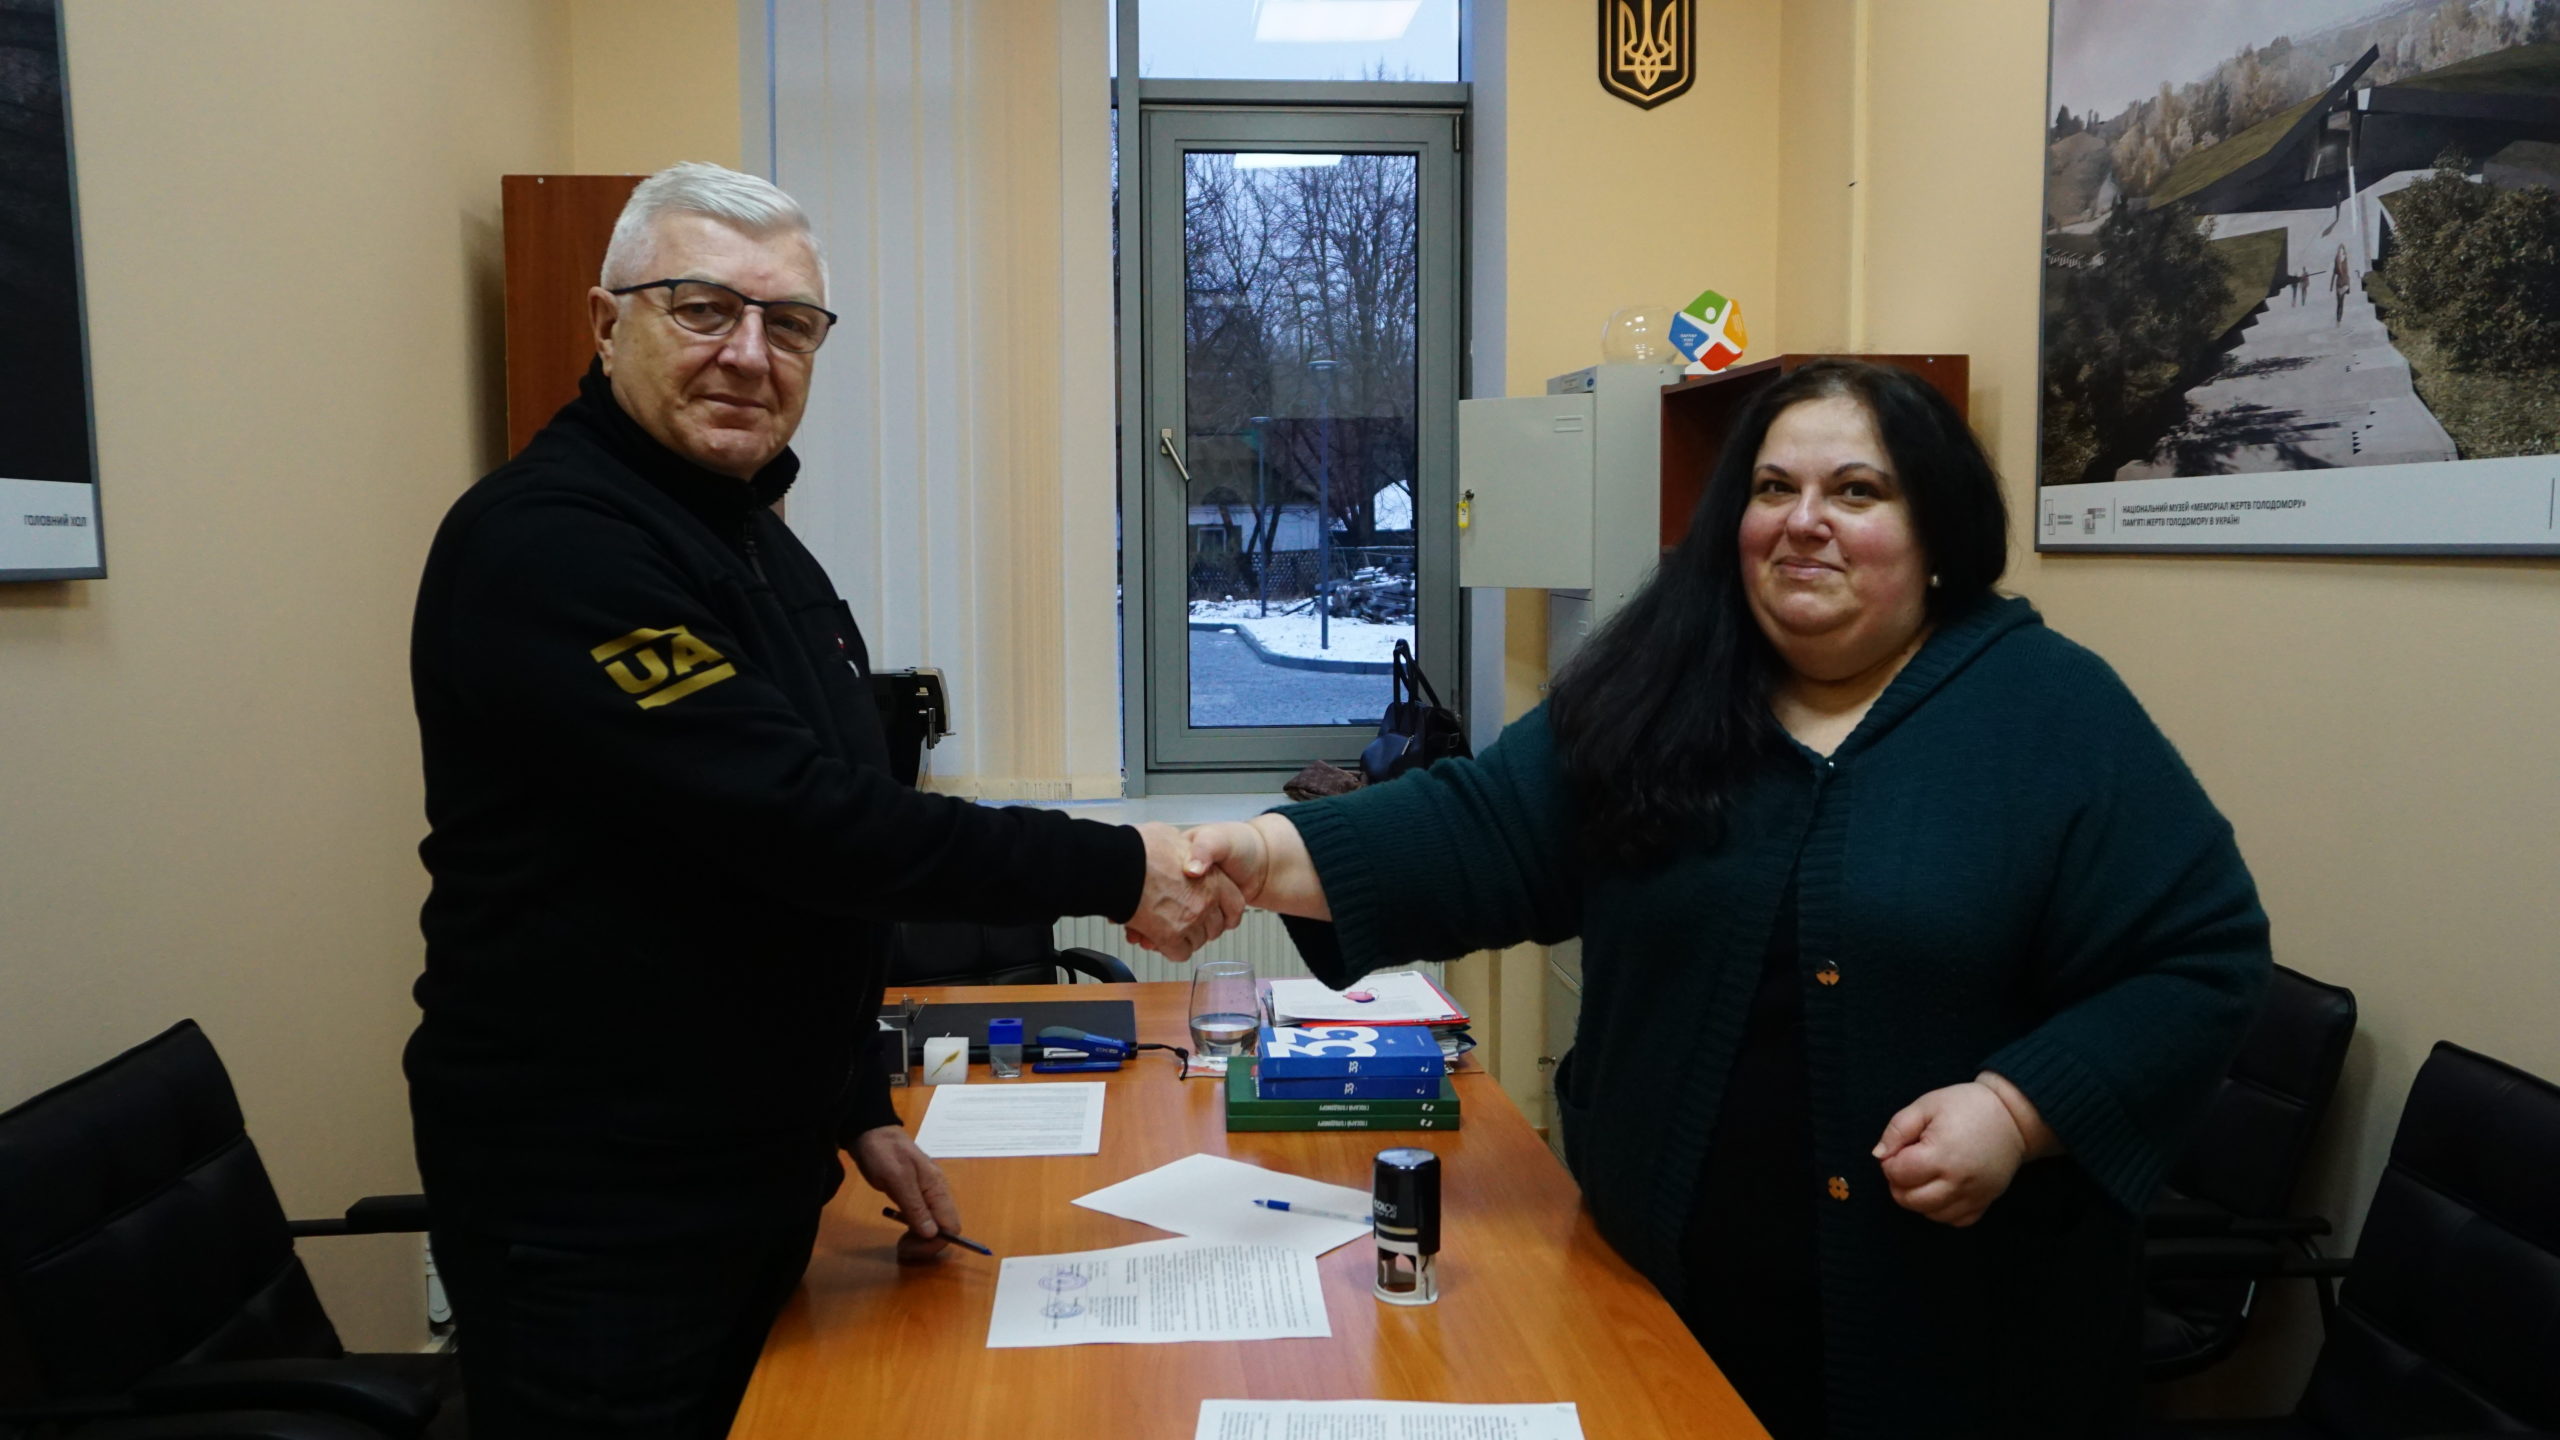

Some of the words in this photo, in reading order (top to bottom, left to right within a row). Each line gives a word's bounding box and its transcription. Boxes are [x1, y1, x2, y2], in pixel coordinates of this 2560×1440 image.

[2122, 502, 2168, 513] НАЦІОНАЛЬНИЙ
[2169, 501, 2189, 512] МУЗЕЙ
[2230, 501, 2251, 510] ЖЕРТВ
[24, 514, 69, 526] ГОЛОВНИЙ
[2146, 518, 2165, 527] ЖЕРТВ
[2167, 517, 2208, 527] ГОЛОДОМОРУ
[2215, 514, 2240, 525] УКРАЇНІ
[604, 633, 724, 693] UA
